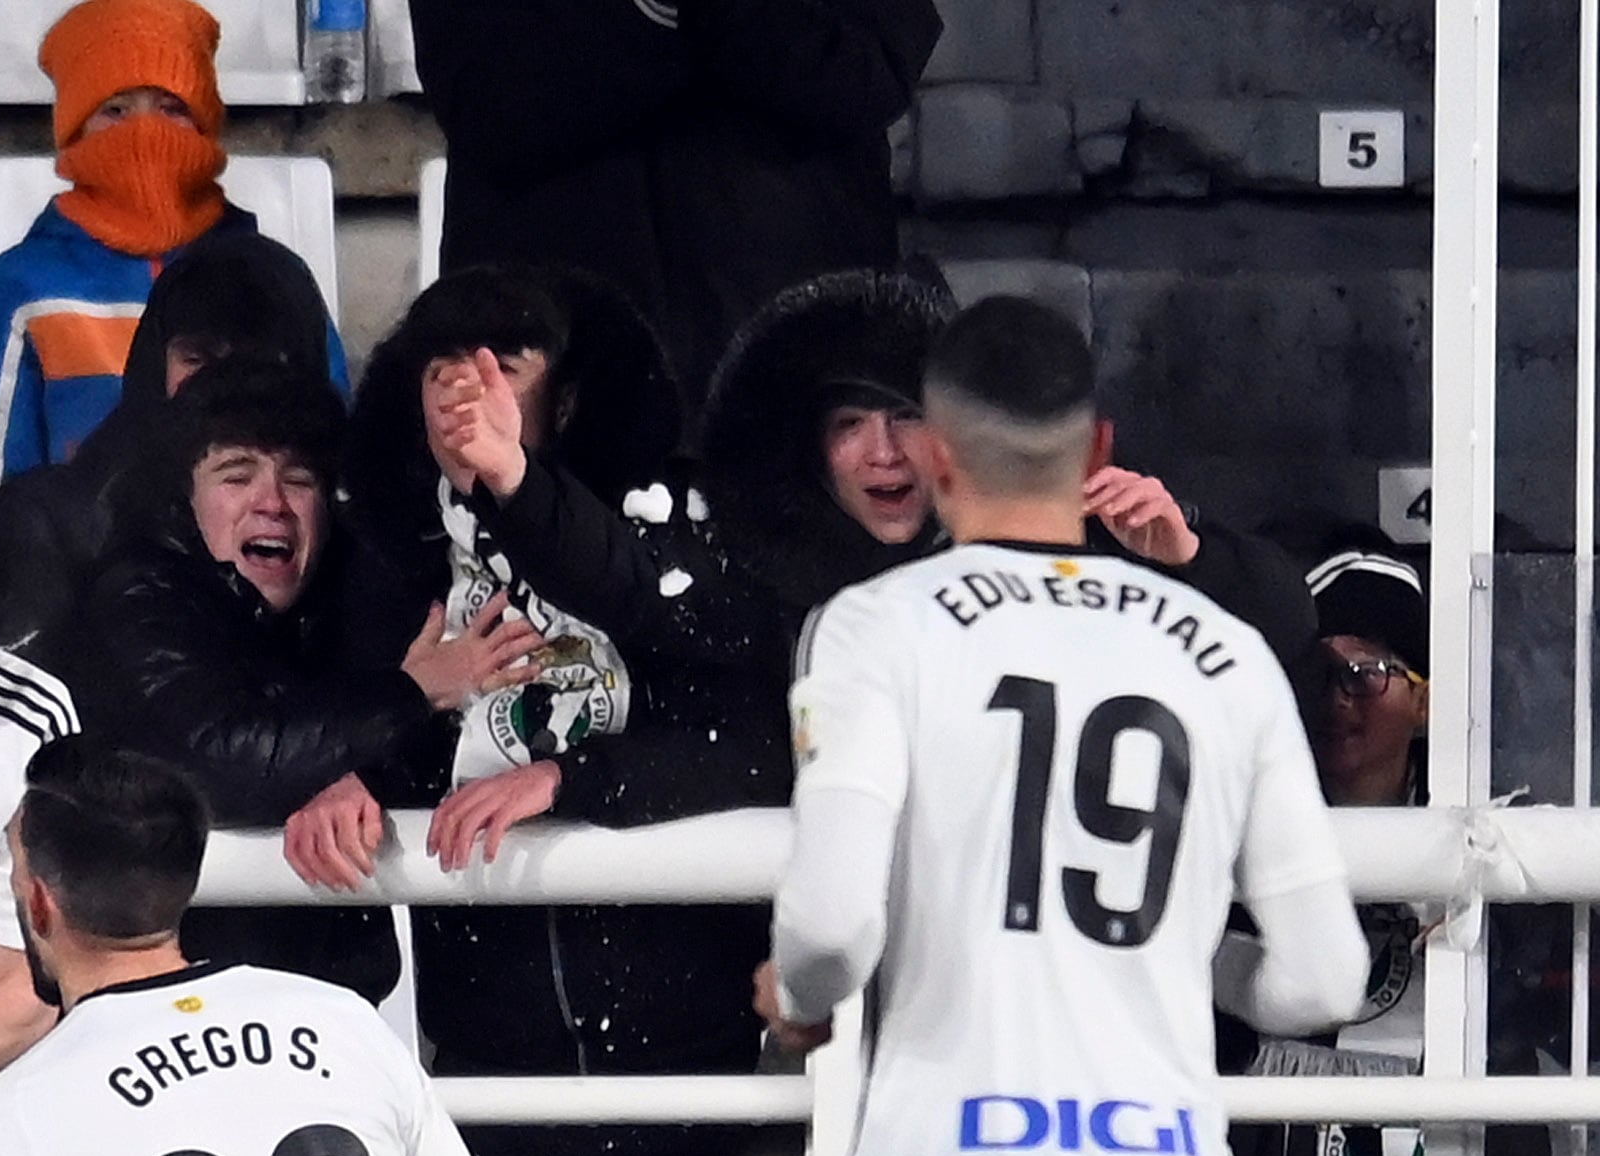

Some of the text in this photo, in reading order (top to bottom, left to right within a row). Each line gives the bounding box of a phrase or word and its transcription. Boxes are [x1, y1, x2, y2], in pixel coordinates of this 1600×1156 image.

[1347, 132, 1377, 169] 5
[934, 571, 1236, 679] EDU ESPIAU
[591, 695, 608, 731] FUT
[987, 674, 1191, 947] 19
[107, 1022, 331, 1107] GREGO S.
[958, 1096, 1200, 1156] DIGI
